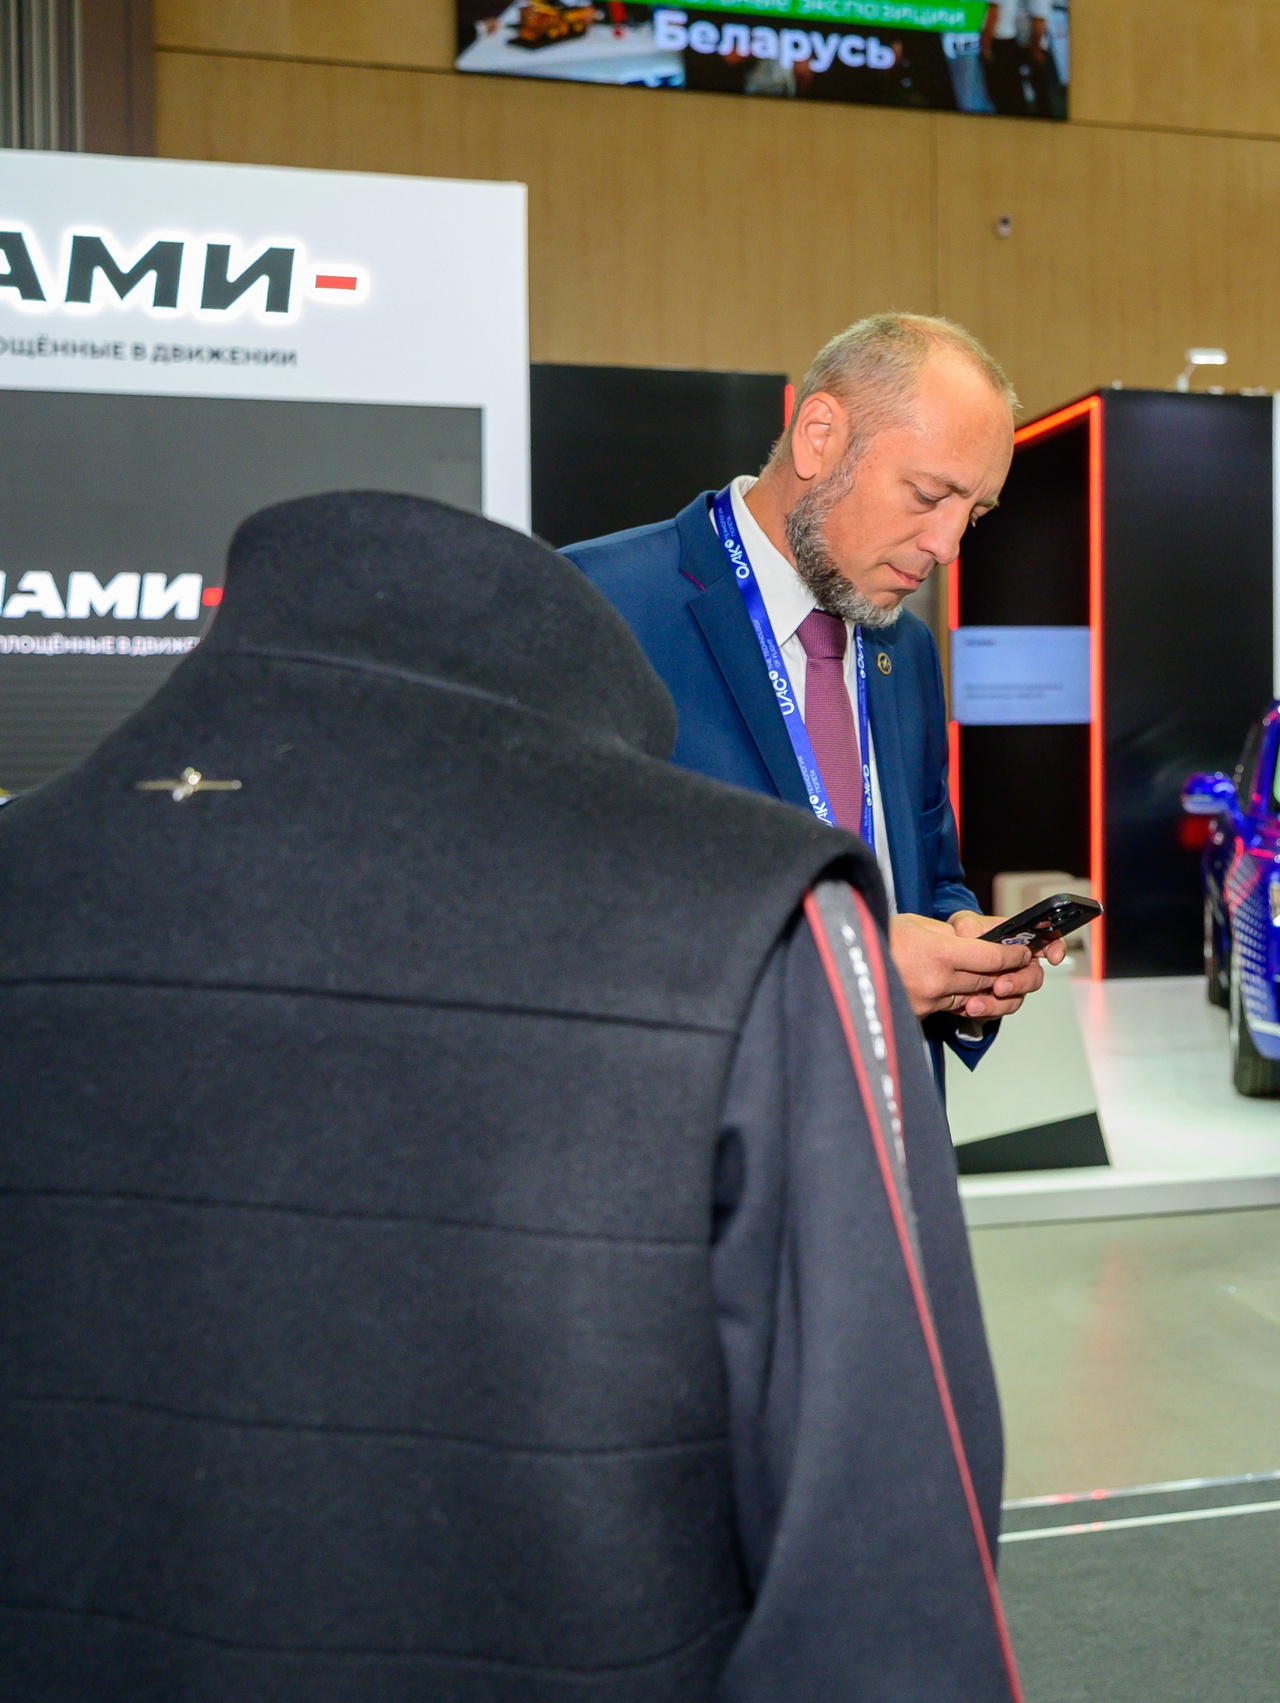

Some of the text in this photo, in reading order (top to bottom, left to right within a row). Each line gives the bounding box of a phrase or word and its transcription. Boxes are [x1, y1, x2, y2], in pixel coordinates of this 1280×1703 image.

[653, 9, 896, 73] Беларусь
[131, 341, 148, 362] В
[152, 342, 298, 368] ДВИЖЕНИИ
[812, 801, 834, 828] АК
